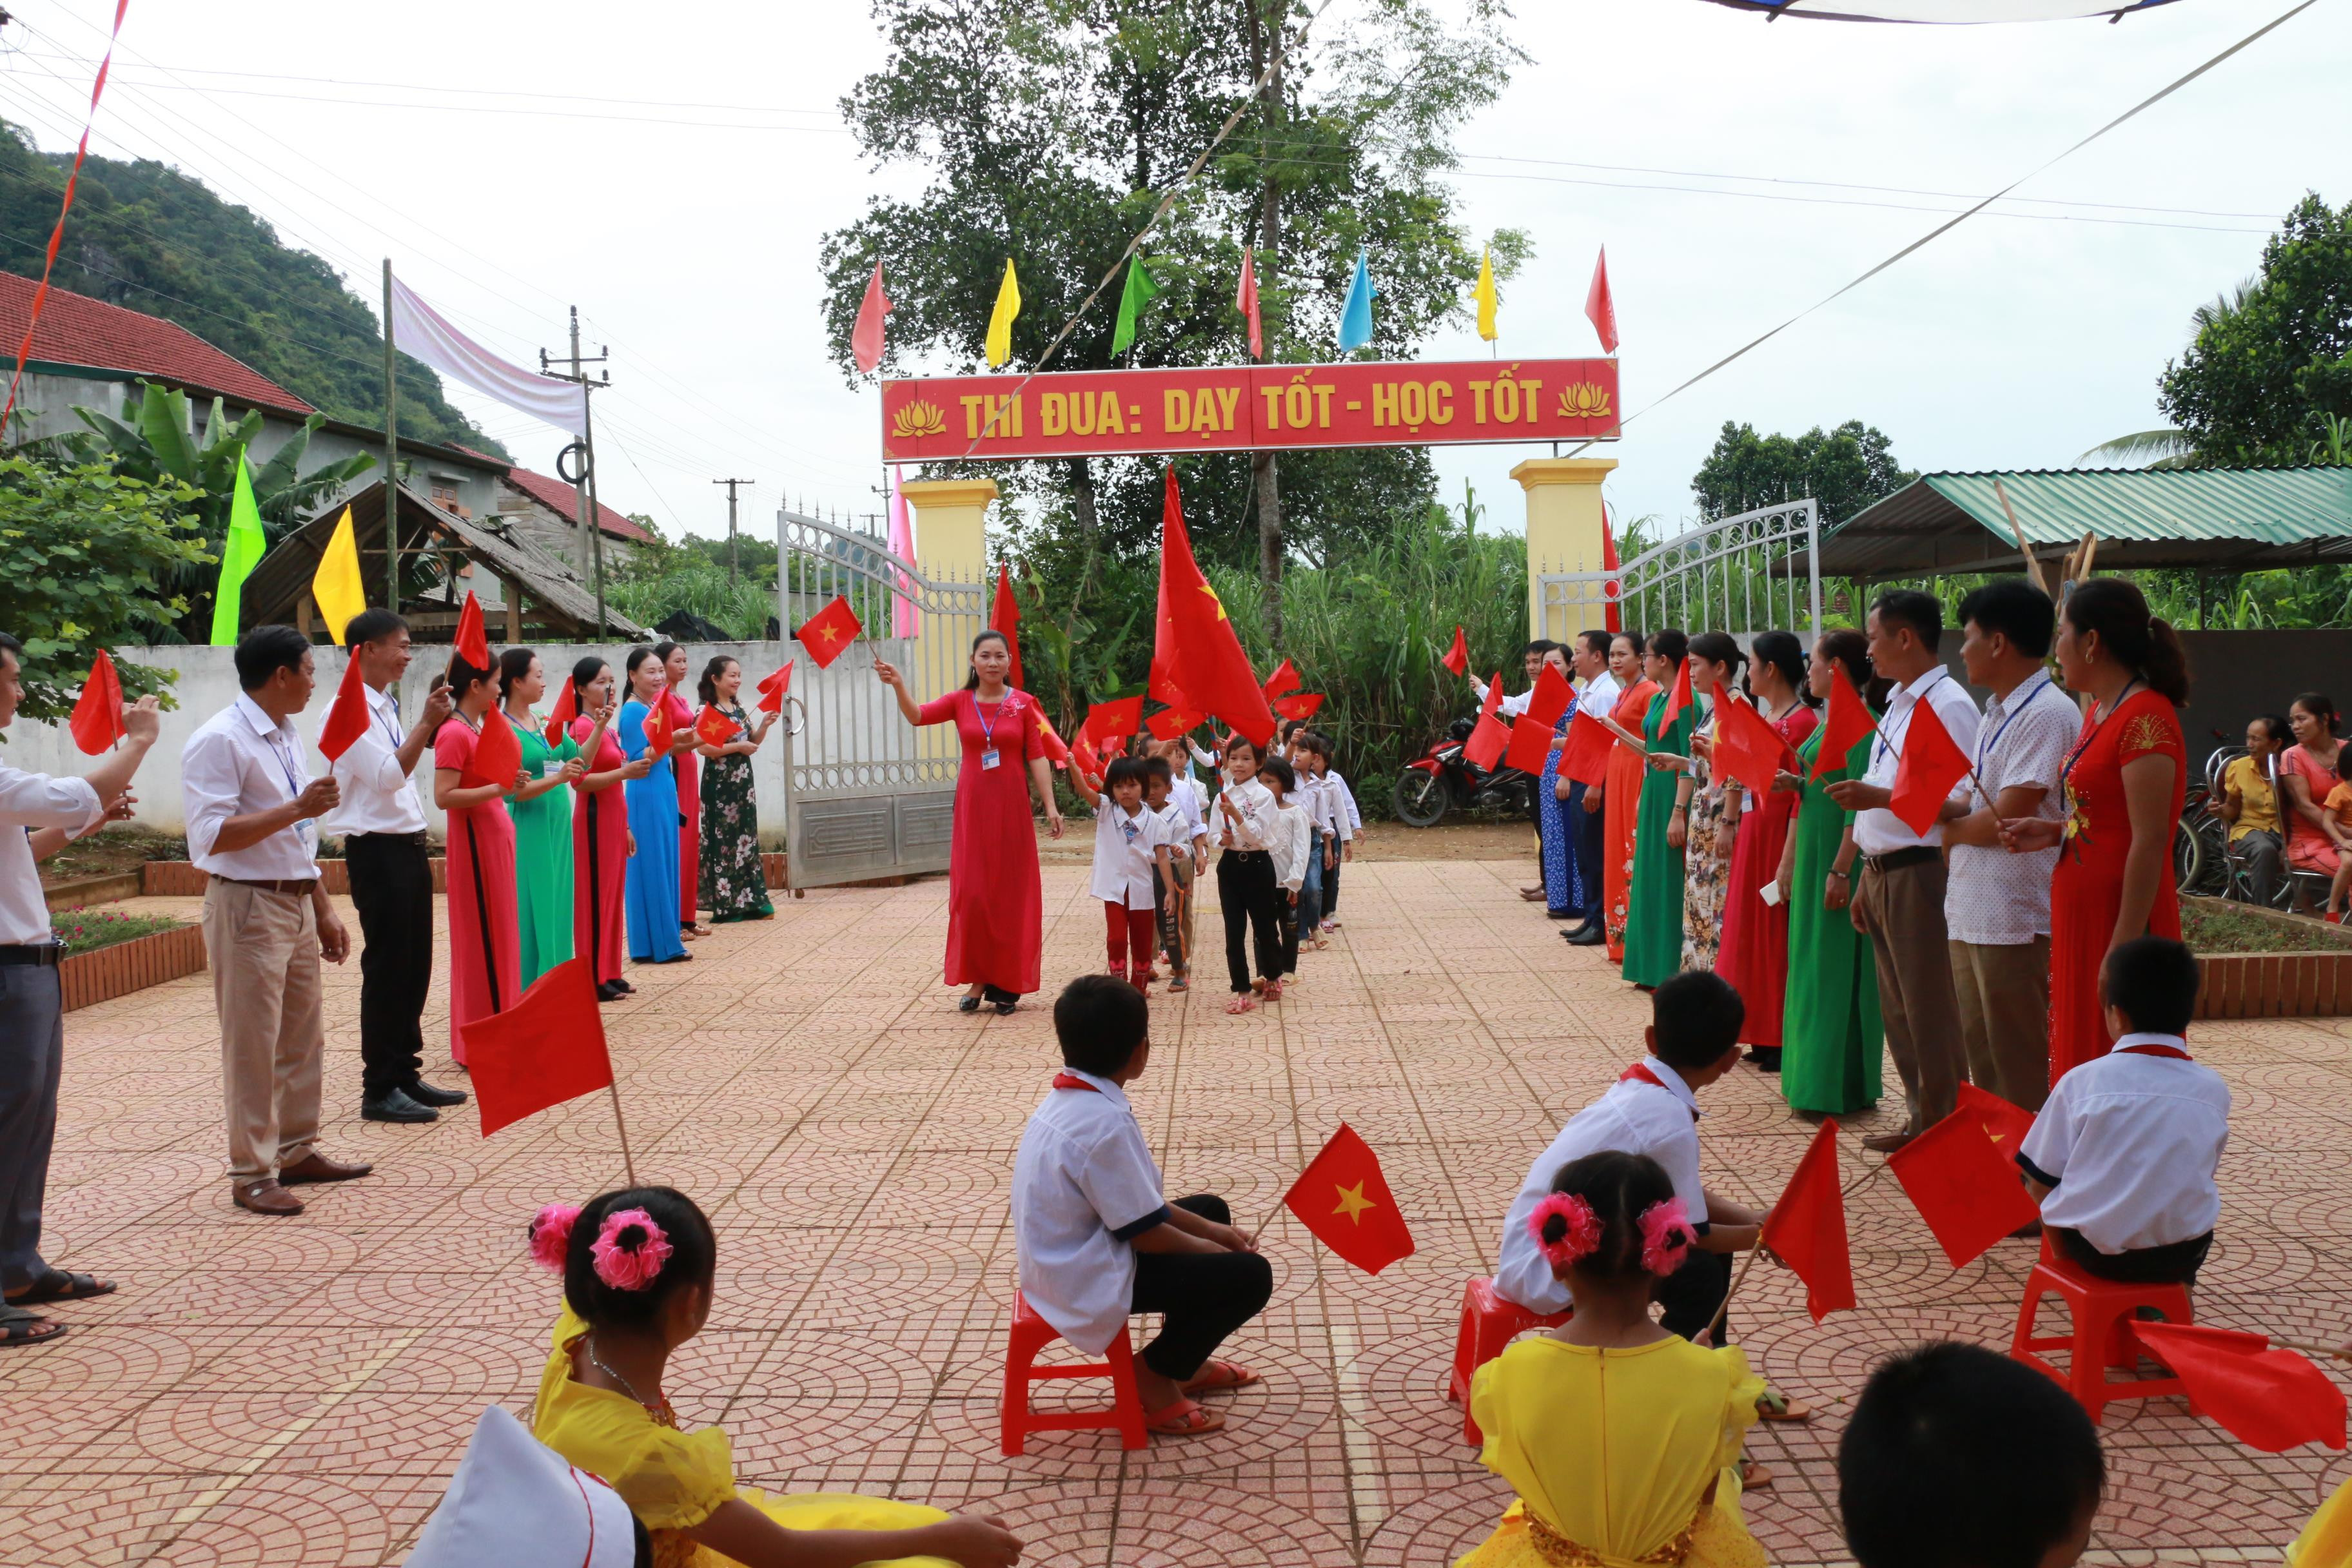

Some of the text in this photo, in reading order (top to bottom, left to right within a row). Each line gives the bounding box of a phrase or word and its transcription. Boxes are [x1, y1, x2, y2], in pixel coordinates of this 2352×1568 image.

[960, 395, 1023, 438] THI
[1040, 391, 1141, 436] ĐUA:
[1164, 387, 1240, 439] DẠY
[1260, 369, 1335, 429] TỐT
[1373, 380, 1453, 433] HỌC
[1469, 363, 1542, 424] TỐT
